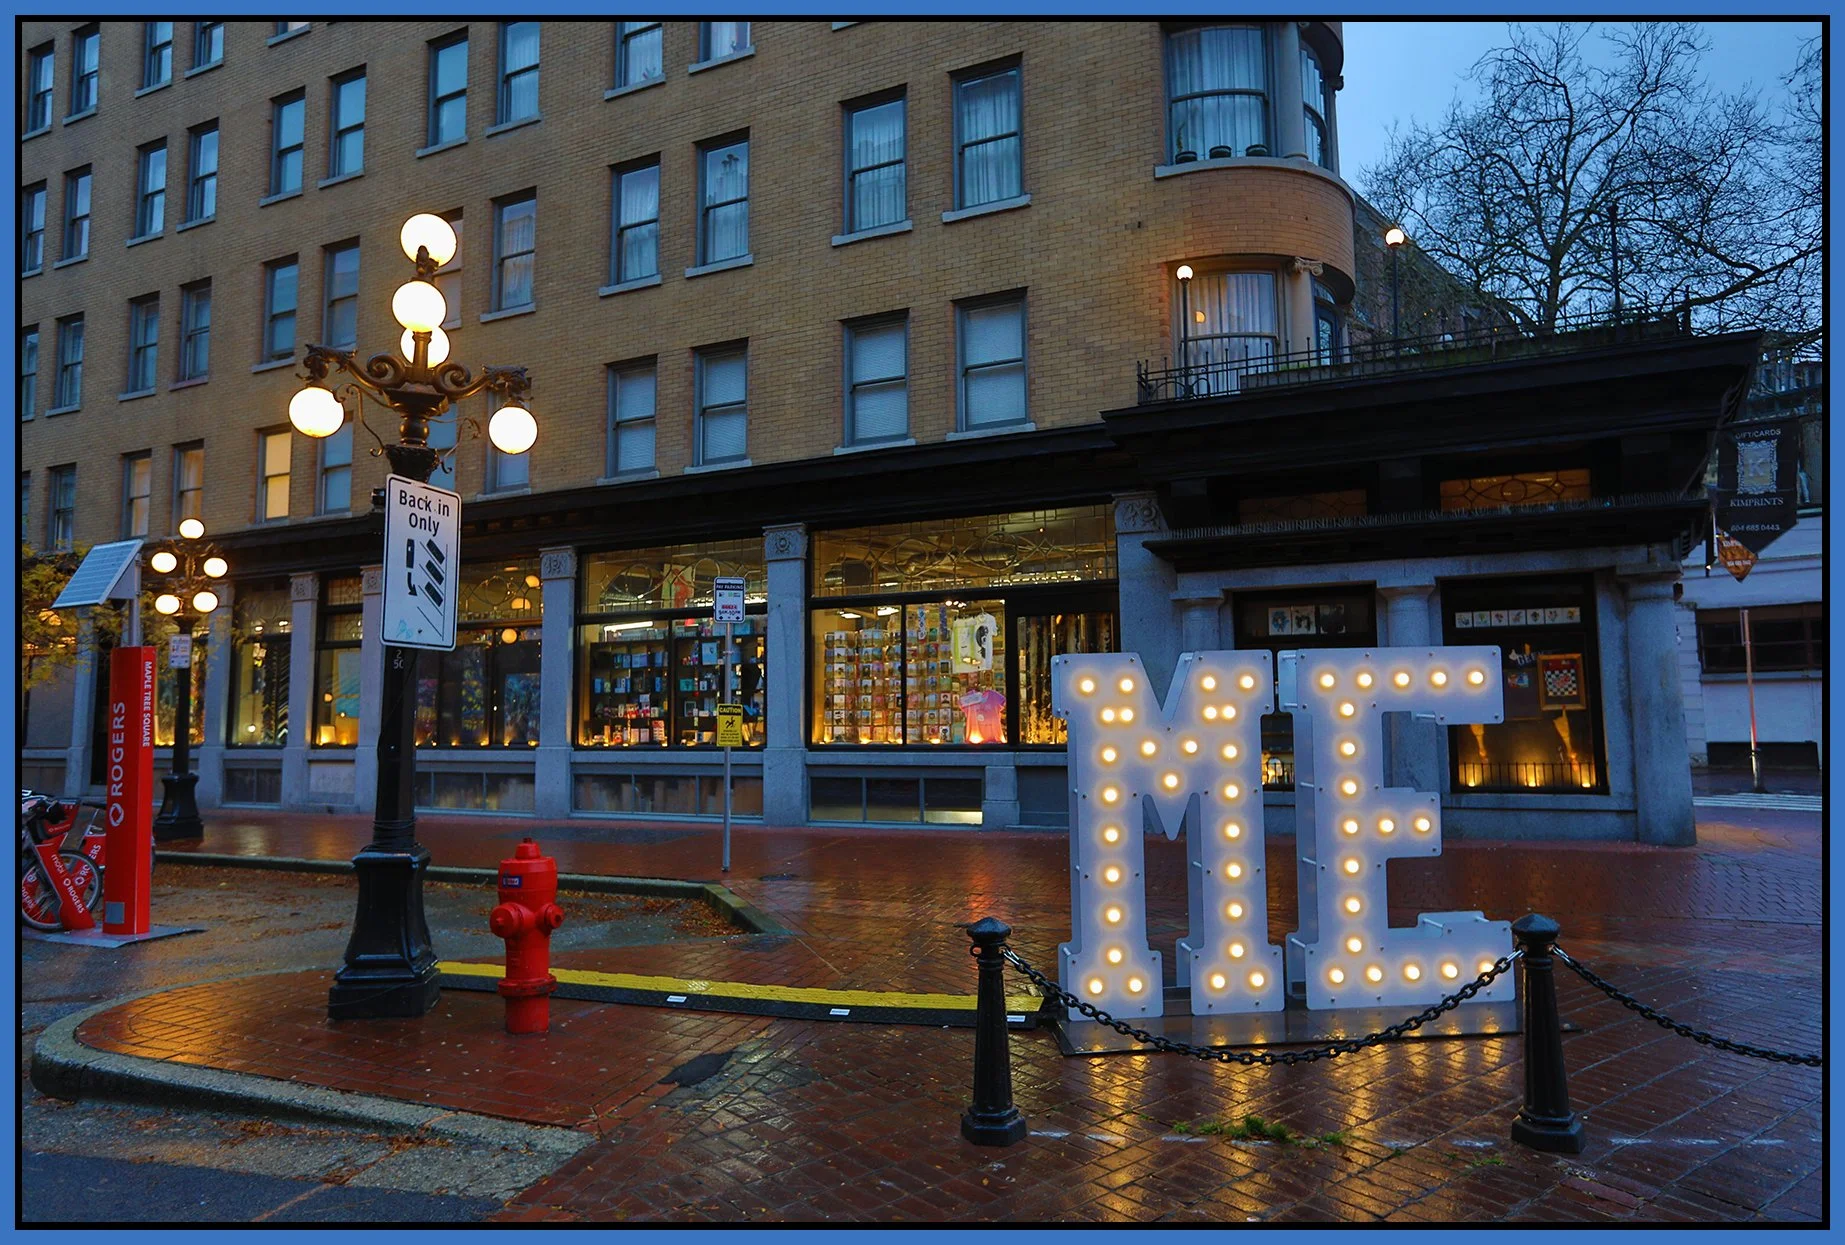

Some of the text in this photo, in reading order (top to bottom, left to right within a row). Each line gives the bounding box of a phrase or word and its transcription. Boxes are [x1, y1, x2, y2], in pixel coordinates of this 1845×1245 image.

[399, 489, 450, 517] Back in
[1730, 497, 1784, 508] KIMPRINTS
[408, 512, 440, 537] Only
[395, 649, 402, 659] 2
[142, 661, 153, 747] MAPLE TREE SQUARE
[111, 702, 126, 797] ROGERS
[1051, 645, 1515, 1020] ME
[51, 854, 66, 874] mobi
[67, 885, 85, 914] ROGERS
